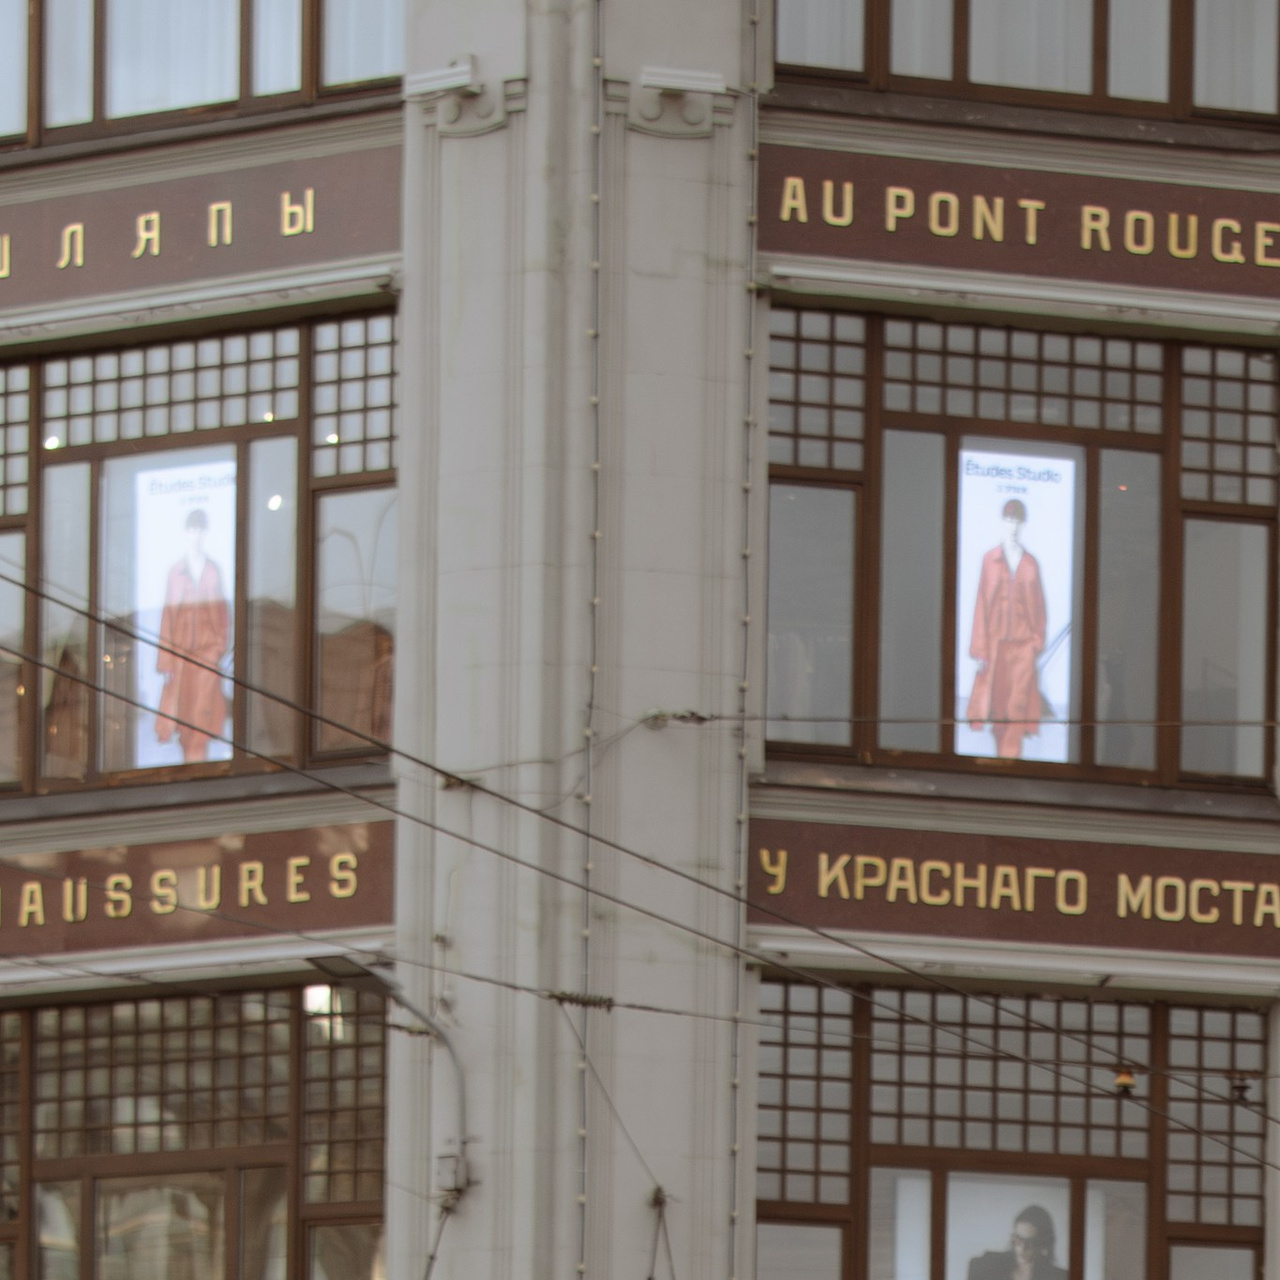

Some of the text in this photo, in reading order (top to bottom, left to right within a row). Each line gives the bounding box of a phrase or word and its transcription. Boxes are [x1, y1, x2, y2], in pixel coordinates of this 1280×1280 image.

[780, 176, 854, 227] AU
[885, 186, 1046, 246] PONT
[18, 853, 359, 927] AUSSURES
[759, 848, 788, 894] У
[817, 852, 1088, 915] КРАСНАГО
